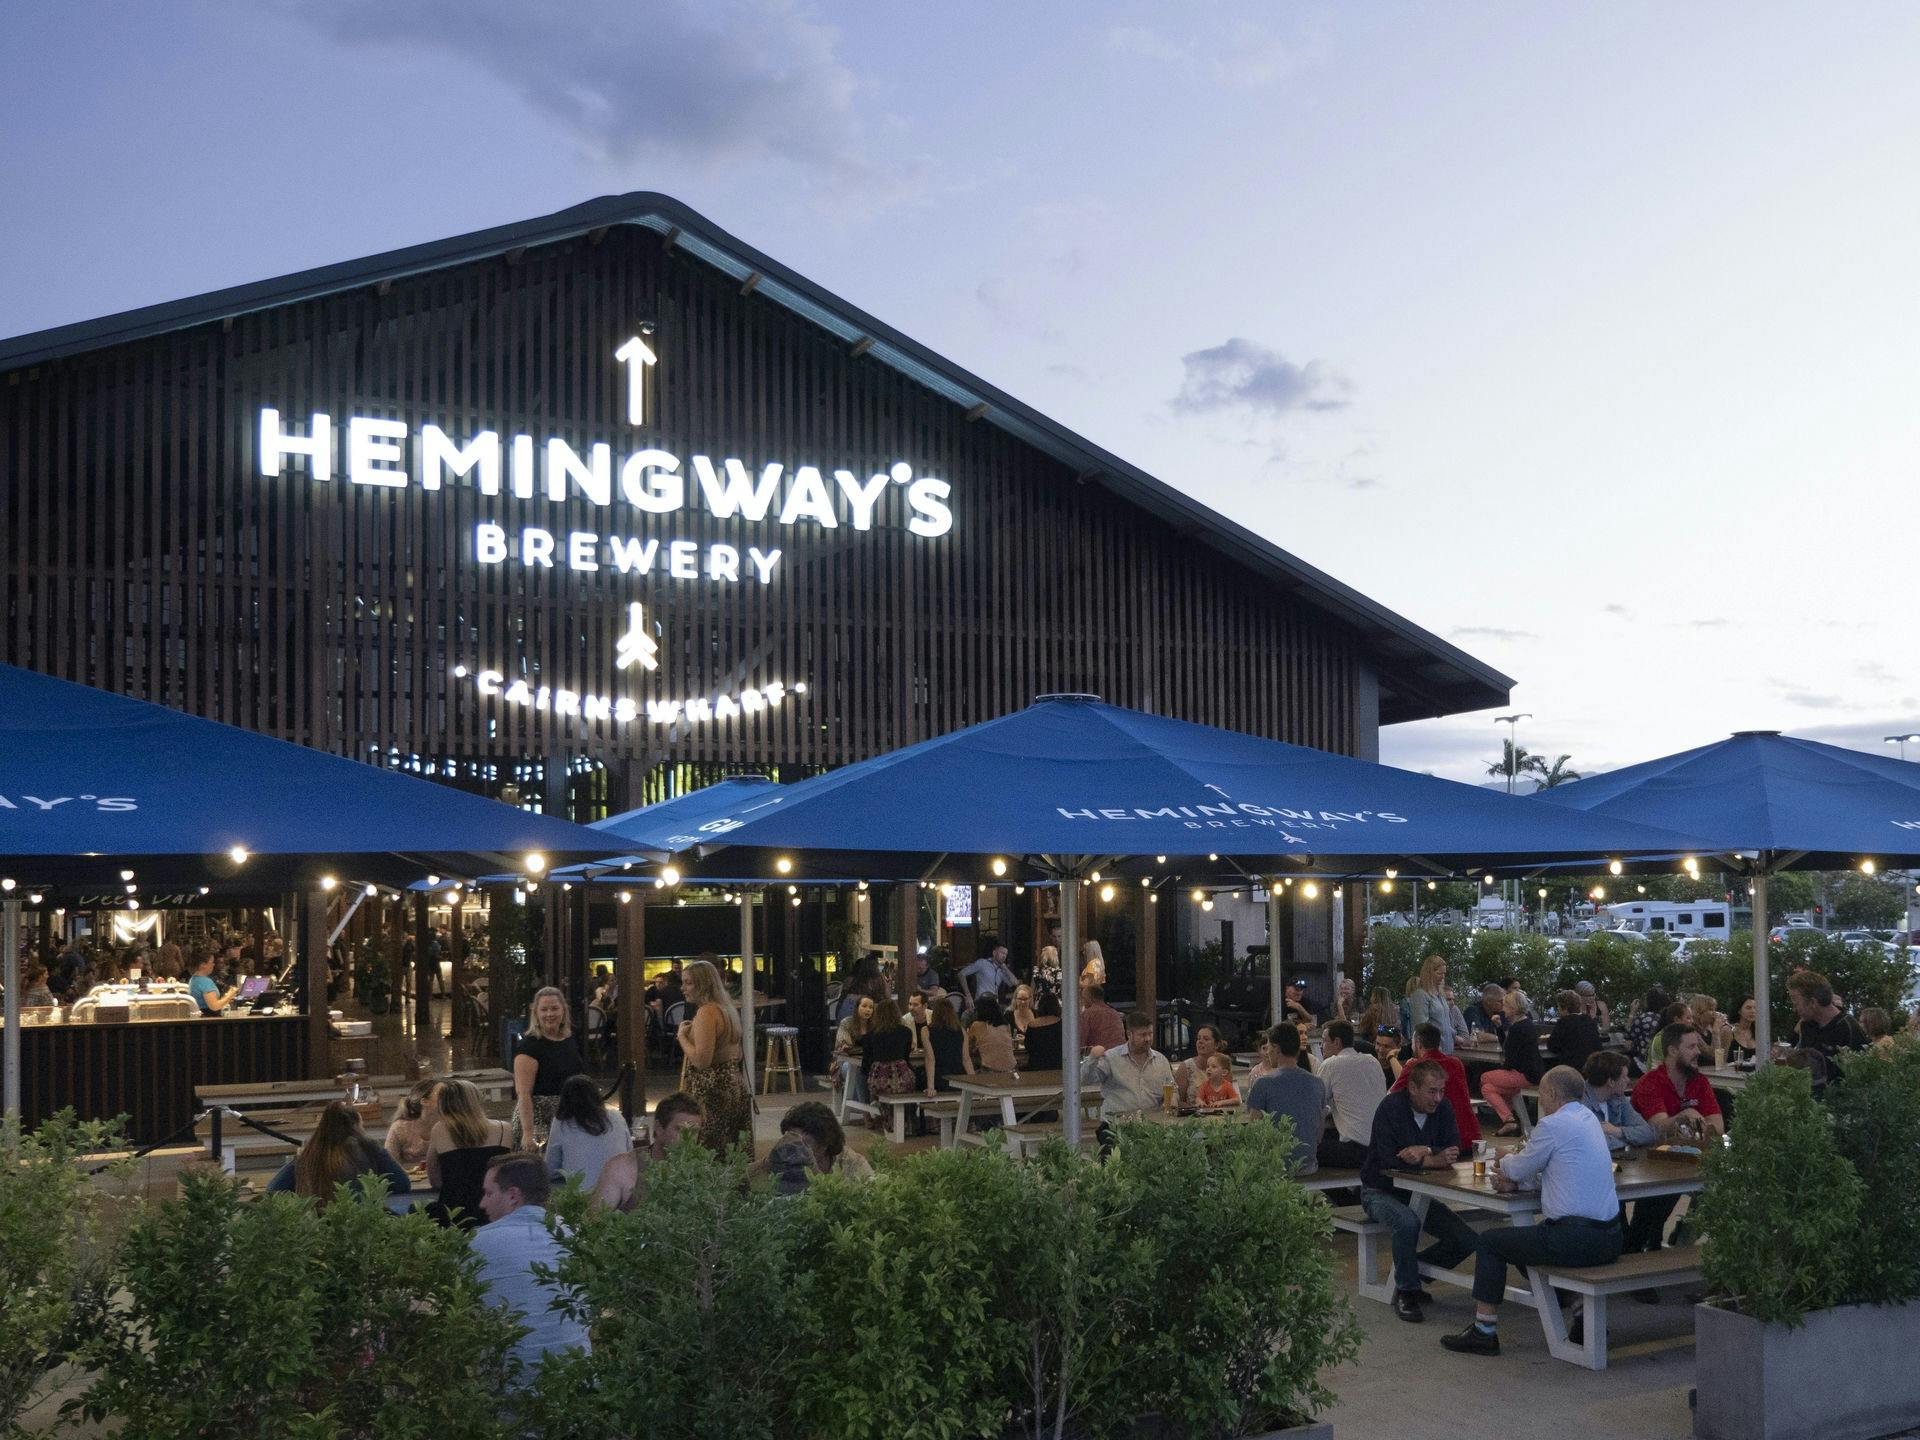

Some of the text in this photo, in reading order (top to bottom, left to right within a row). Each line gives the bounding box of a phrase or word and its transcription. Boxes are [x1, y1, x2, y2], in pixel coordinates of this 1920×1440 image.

[475, 522, 782, 585] BREWERY
[477, 670, 786, 723] CAIRNS WHARF
[1183, 818, 1338, 830] BREWERY
